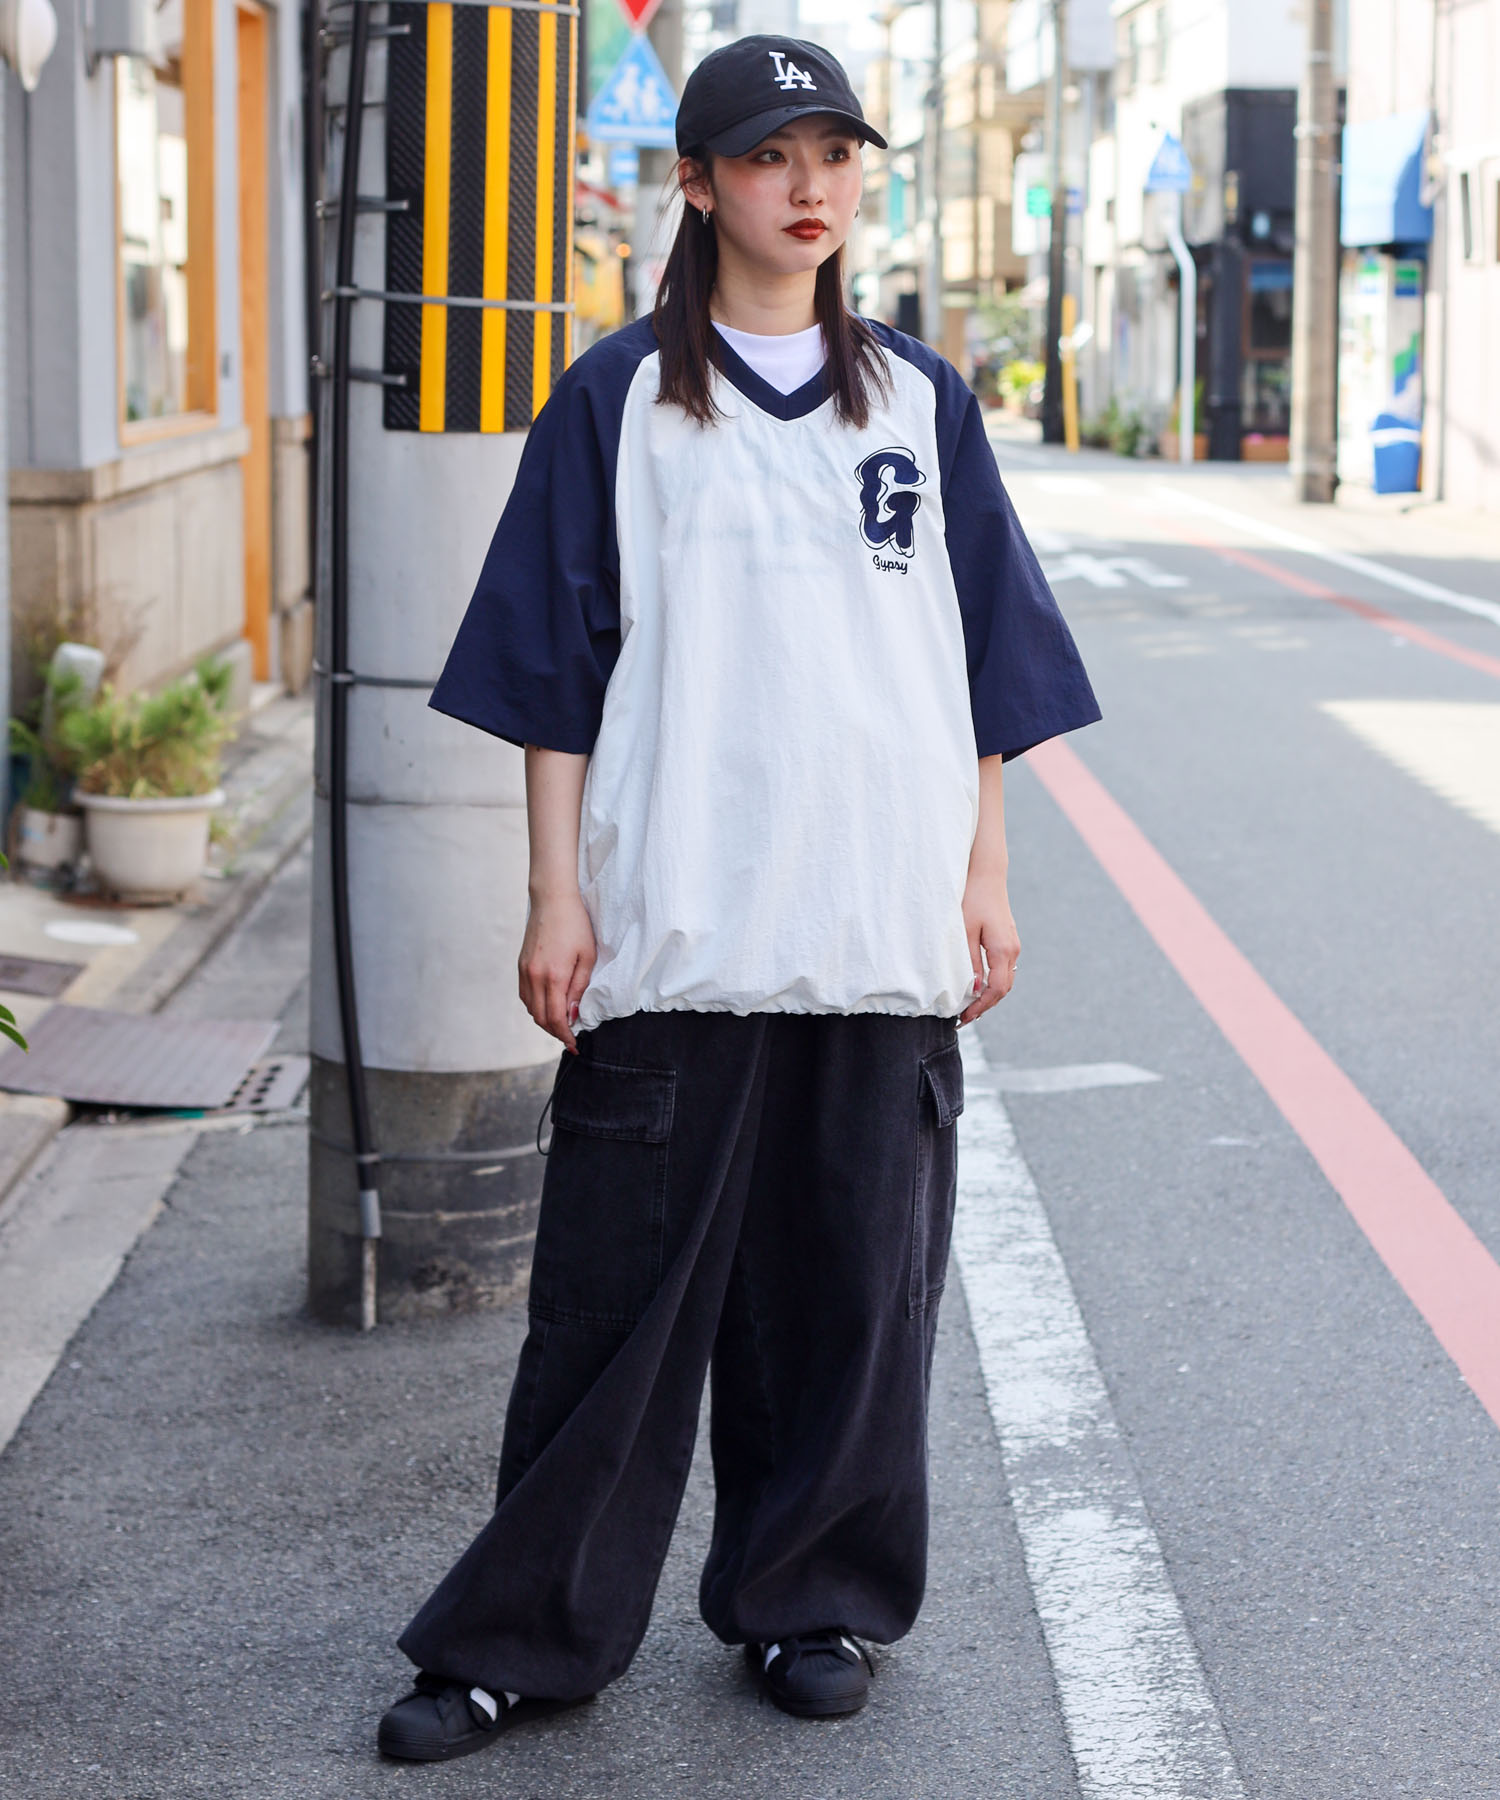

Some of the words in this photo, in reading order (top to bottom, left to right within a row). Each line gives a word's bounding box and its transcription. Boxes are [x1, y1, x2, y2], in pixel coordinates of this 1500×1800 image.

[768, 51, 818, 91] LA
[854, 446, 927, 559] G
[872, 554, 909, 575] Gypsy
